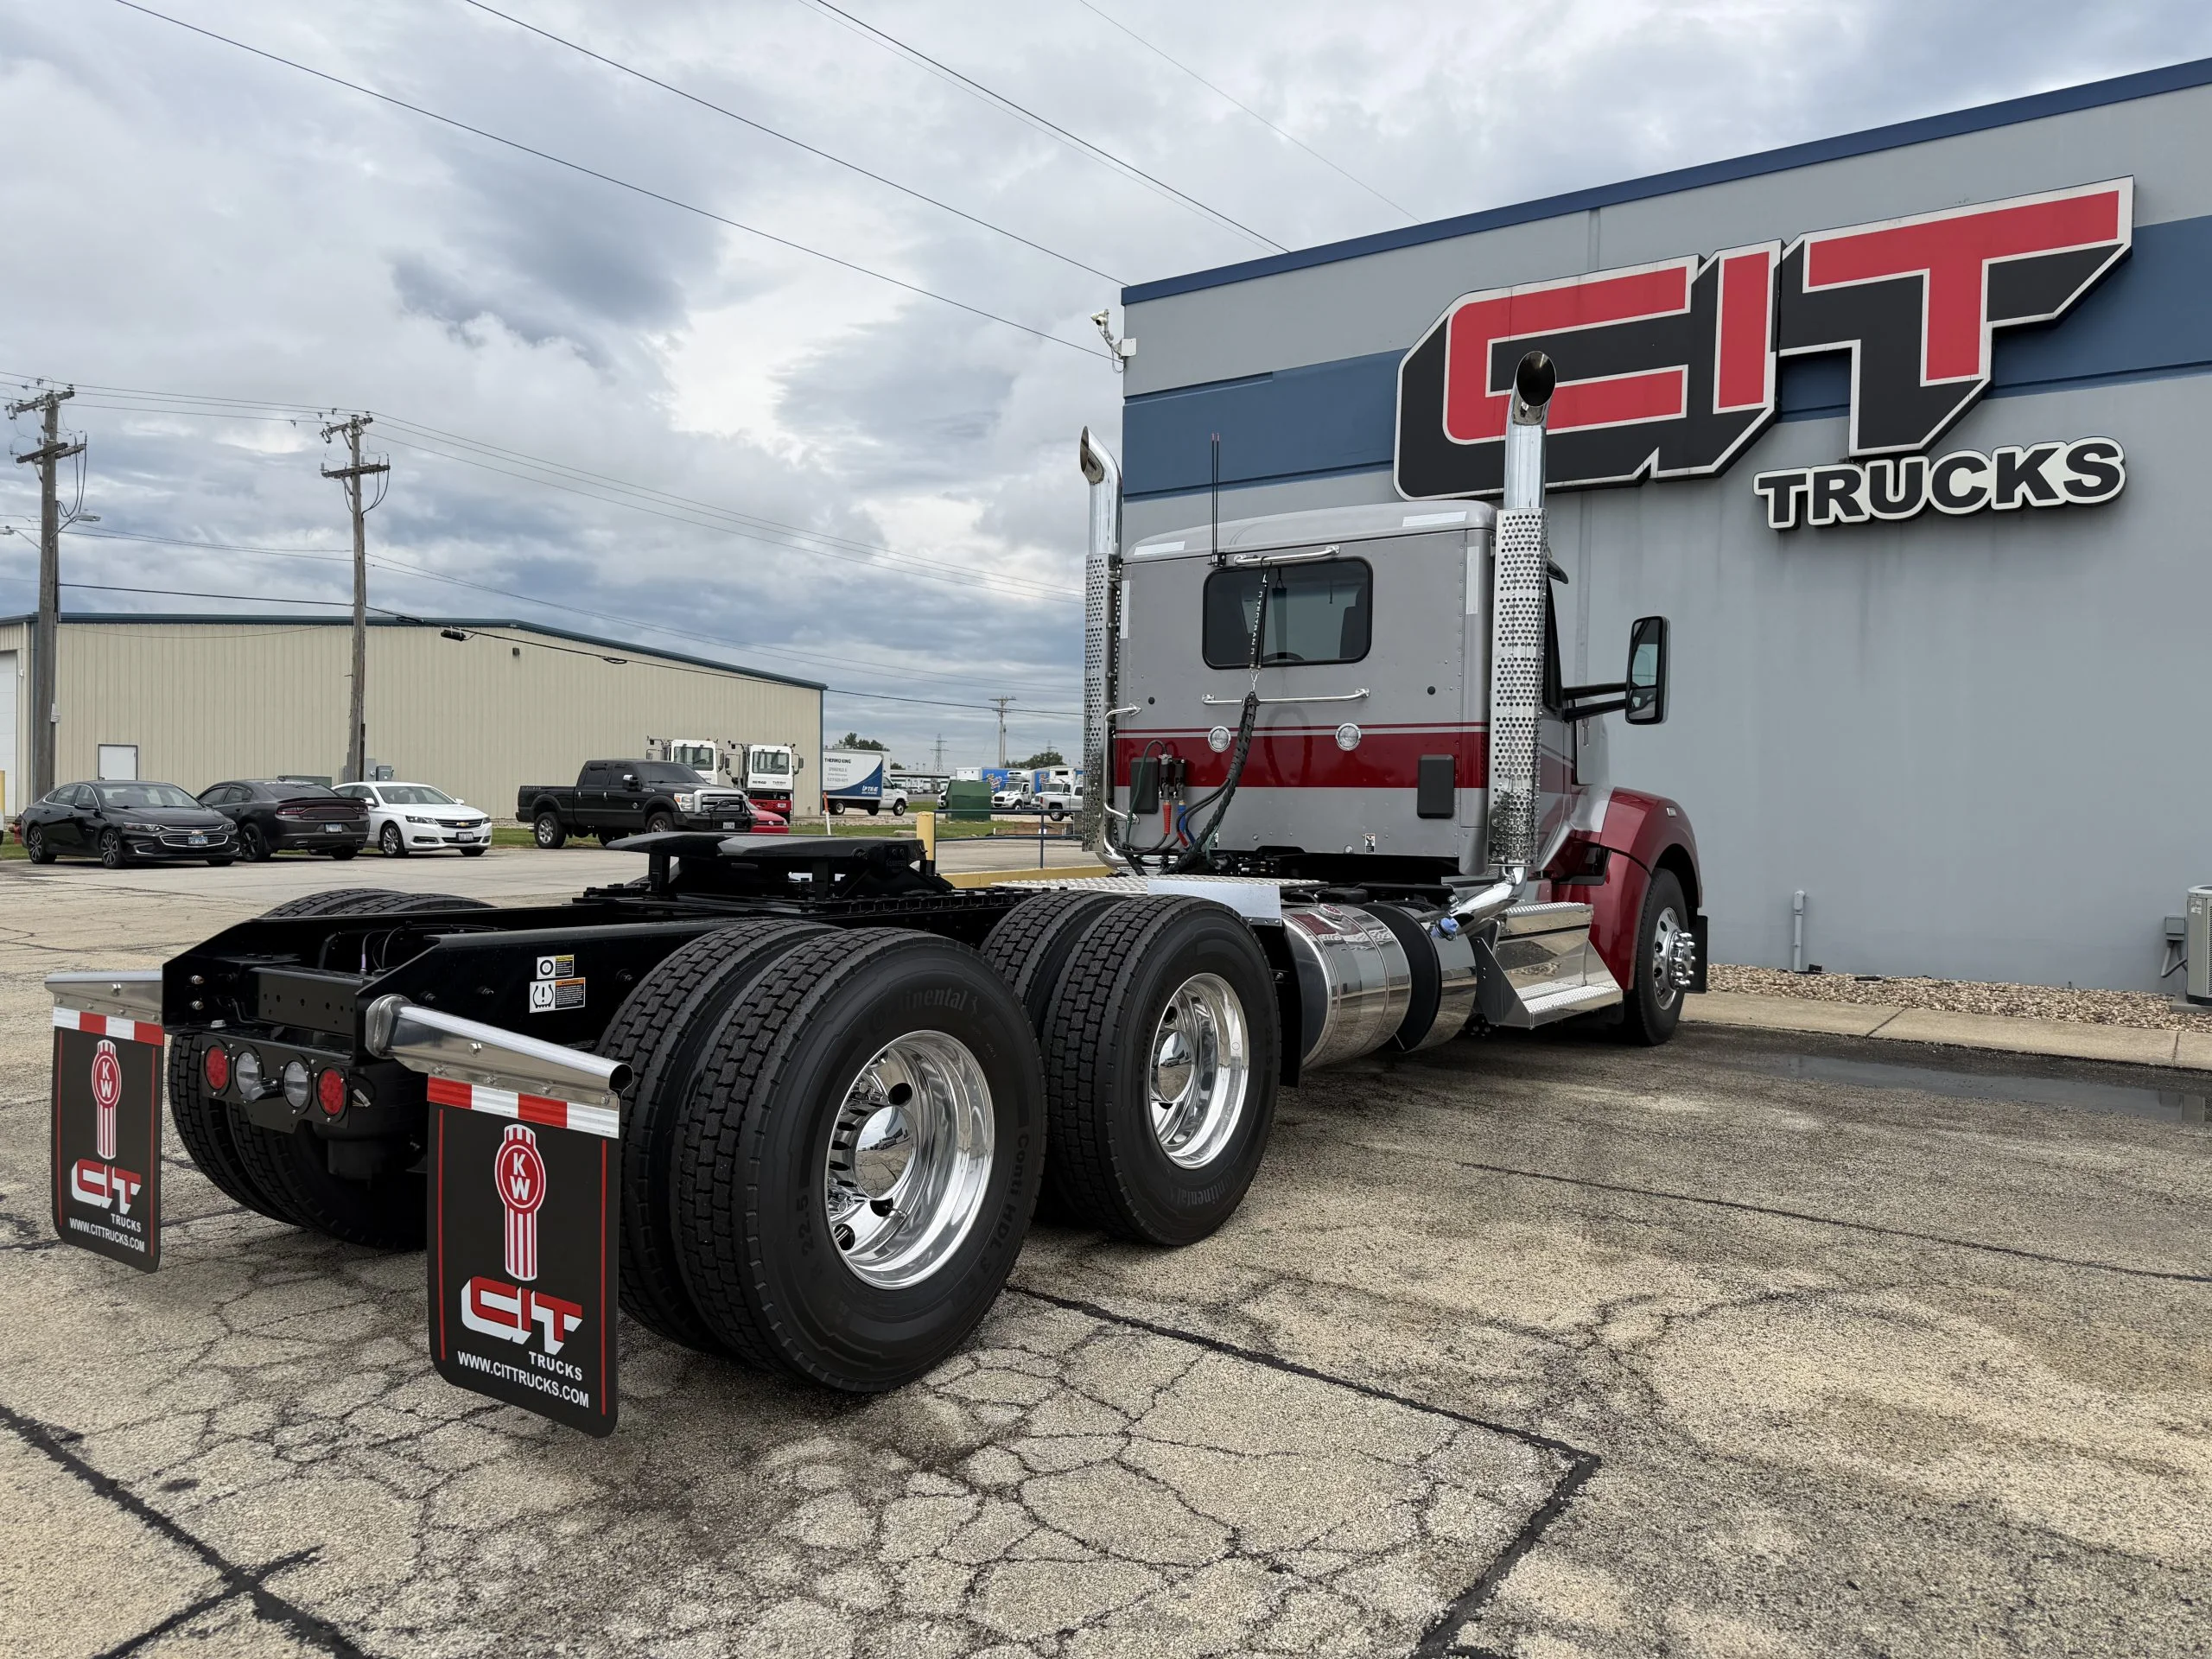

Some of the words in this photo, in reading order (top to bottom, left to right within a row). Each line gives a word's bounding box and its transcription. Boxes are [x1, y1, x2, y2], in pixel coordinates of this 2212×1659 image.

[1403, 178, 2132, 489] CIT
[1756, 439, 2123, 528] TRUCKS
[71, 1158, 141, 1214] CIT
[1009, 1132, 1030, 1197] Conti
[69, 1217, 145, 1253] WWW.CITTRUCKS.COM
[110, 1212, 142, 1233] TRUCKS
[461, 1275, 582, 1356] CIT
[457, 1351, 589, 1408] WWW.CITTRUCKS.COM
[528, 1351, 582, 1382] TRUCKS
